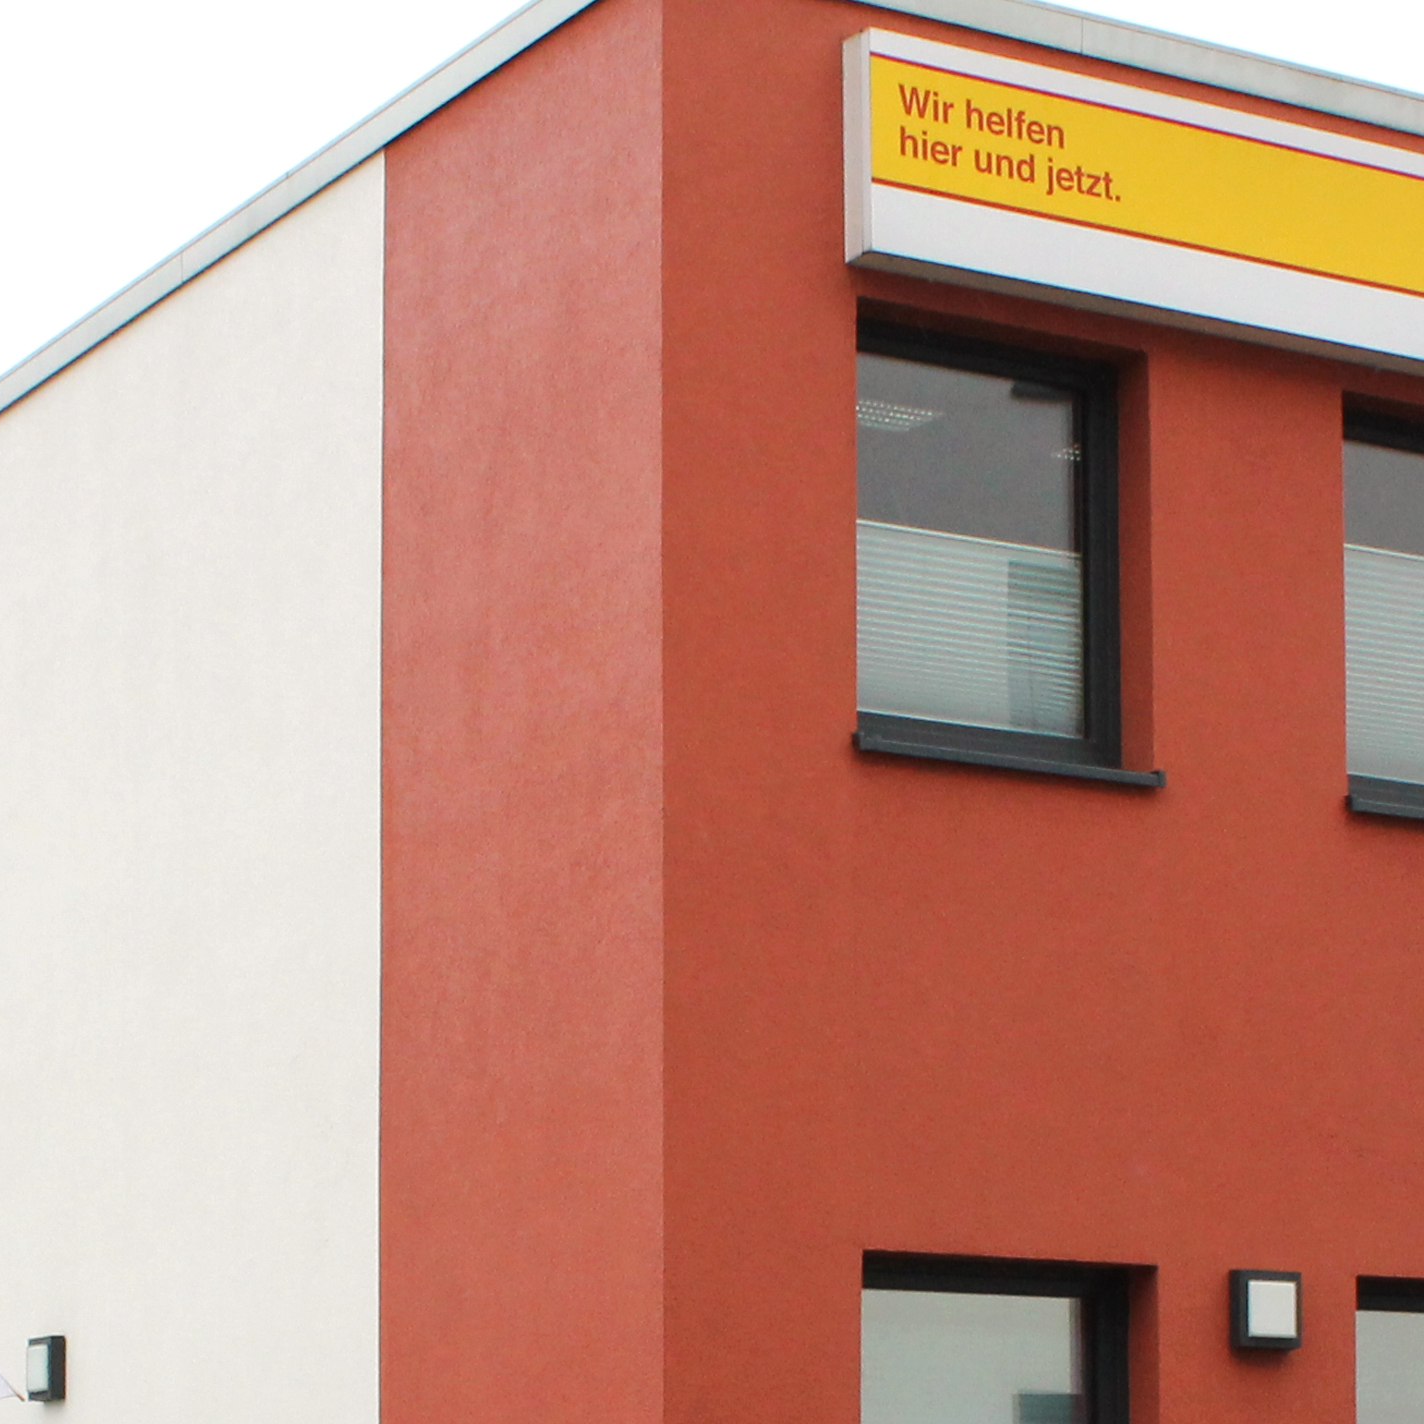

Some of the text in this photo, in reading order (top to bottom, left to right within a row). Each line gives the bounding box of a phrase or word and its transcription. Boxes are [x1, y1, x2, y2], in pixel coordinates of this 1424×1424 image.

[898, 82, 1065, 150] Wir helfen
[899, 125, 1122, 203] hier und jetzt.
